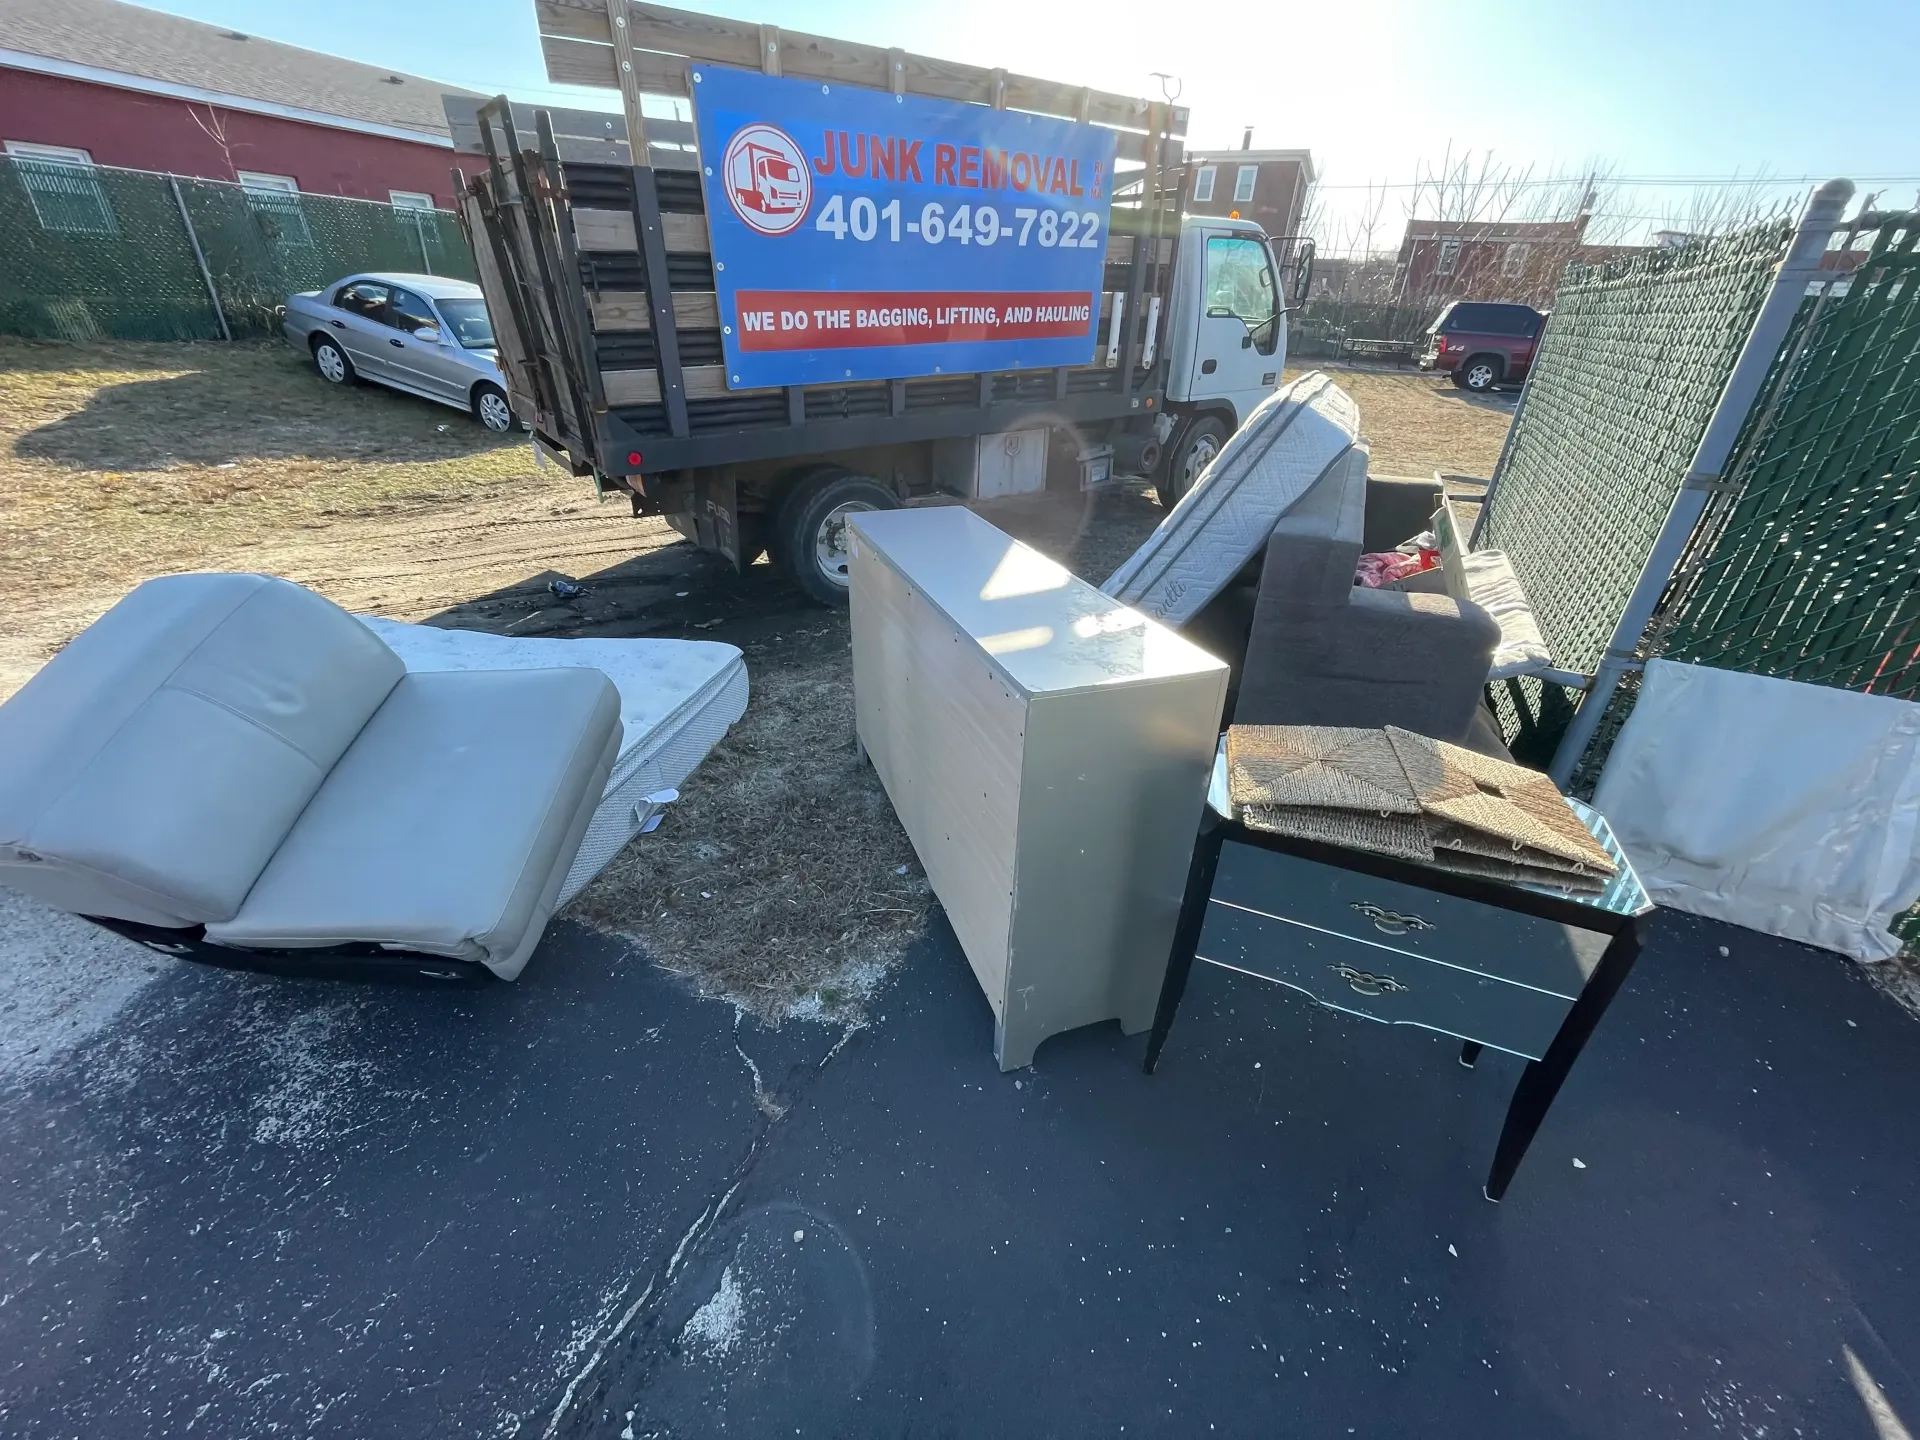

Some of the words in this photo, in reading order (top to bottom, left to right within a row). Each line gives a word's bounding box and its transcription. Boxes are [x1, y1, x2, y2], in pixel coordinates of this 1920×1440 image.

[813, 129, 923, 184] JUNK
[935, 143, 1084, 197] REMOVAL
[816, 195, 1100, 248] 401-649-7822
[743, 311, 775, 332] WE
[780, 310, 808, 331] DO
[813, 309, 850, 329] THE
[856, 307, 932, 328] BAGGING,
[936, 306, 1000, 327] LIFTING,
[1004, 306, 1032, 324] AND
[1036, 305, 1089, 323] HAULING
